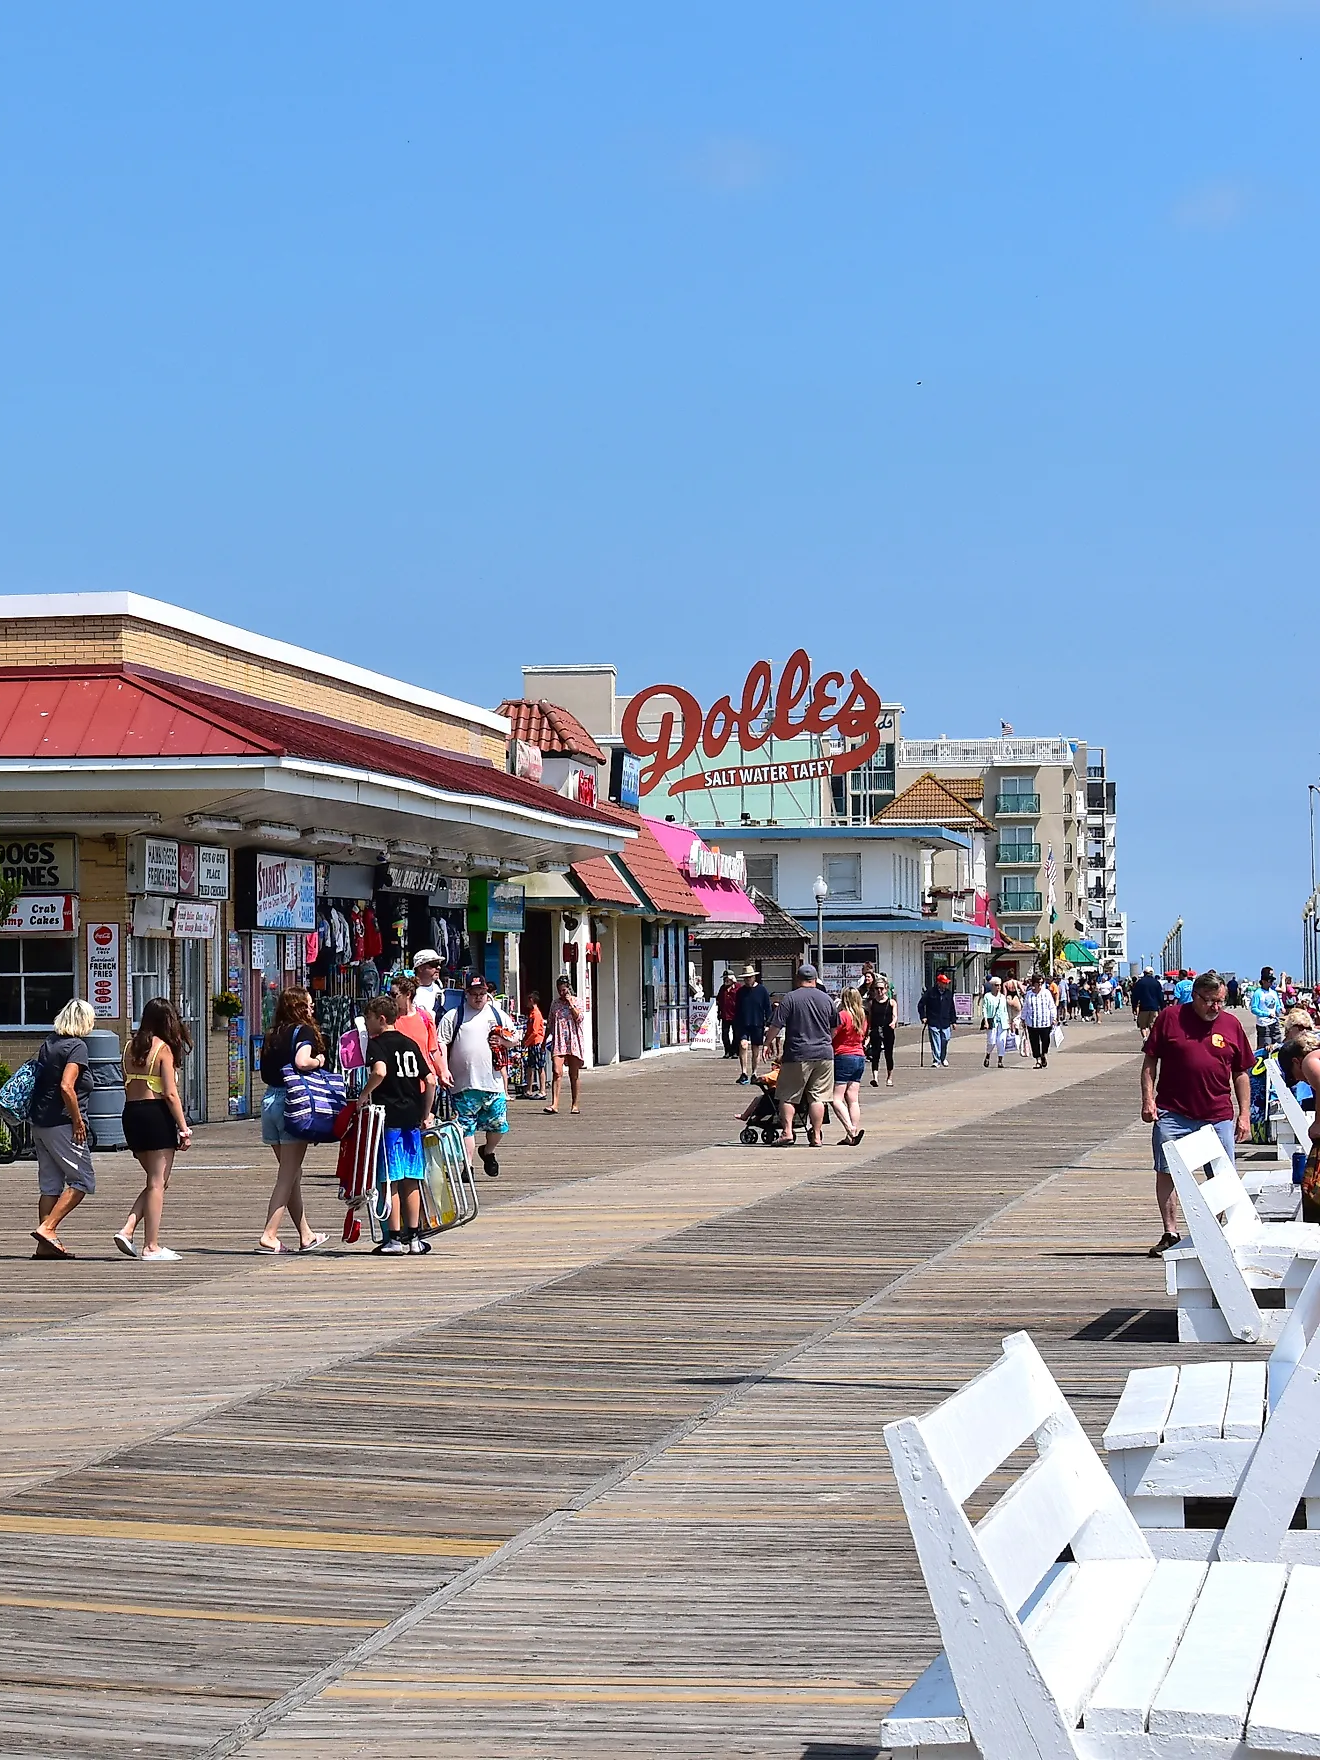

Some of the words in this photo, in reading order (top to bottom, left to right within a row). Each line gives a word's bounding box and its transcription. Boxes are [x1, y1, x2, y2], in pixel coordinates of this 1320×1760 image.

[704, 770, 735, 787] SALT
[739, 764, 788, 784] WATER
[792, 759, 835, 779] TAFFY
[206, 868, 221, 880] PLACE
[31, 903, 57, 914] Crab
[29, 915, 60, 926] Cakes
[90, 963, 117, 971] FRENCH
[93, 970, 113, 978] FRIES
[394, 1050, 420, 1078] 10
